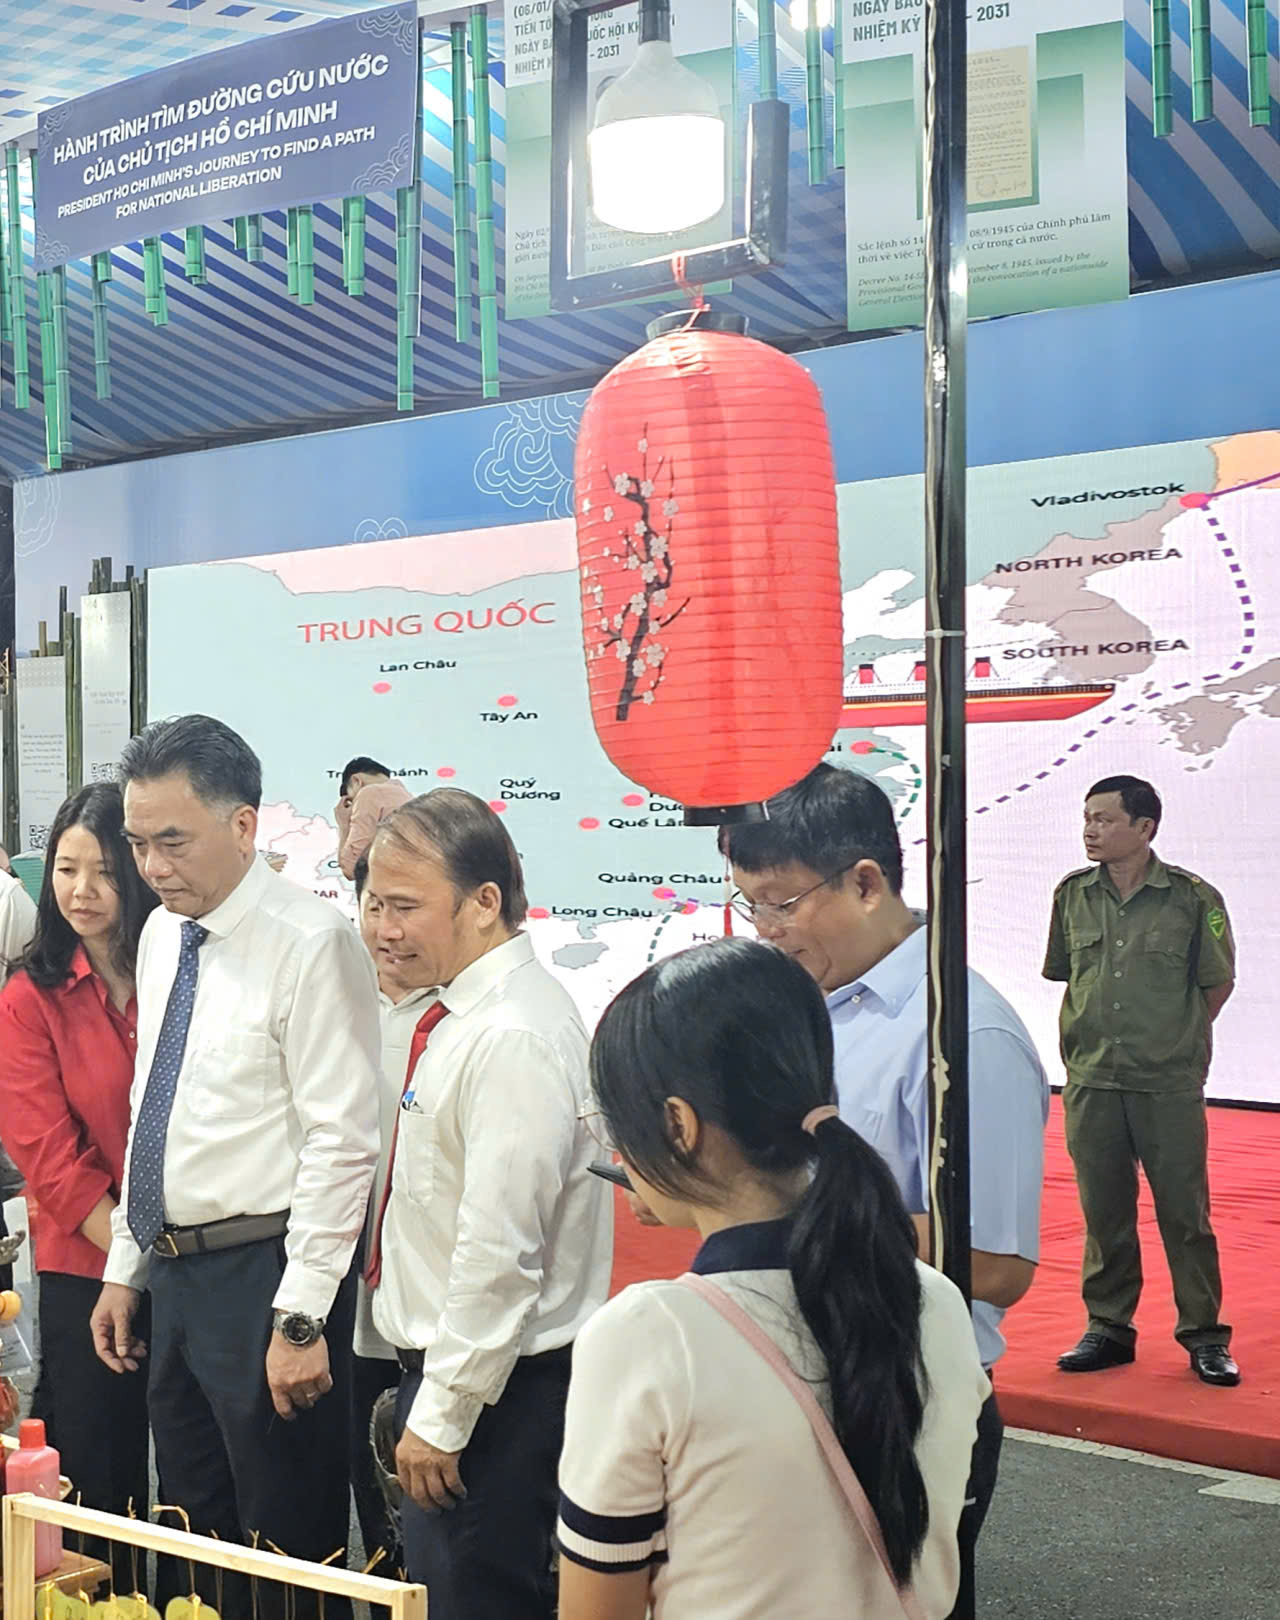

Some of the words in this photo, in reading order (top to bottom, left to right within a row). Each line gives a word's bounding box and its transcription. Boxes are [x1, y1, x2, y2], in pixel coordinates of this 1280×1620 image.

[853, 19, 896, 42] NHIỆM
[977, 3, 1009, 21] 2031
[597, 44, 620, 59] 2031
[54, 133, 98, 165] HÀNH
[100, 114, 149, 148] TRÌNH
[152, 104, 185, 131] TÌM
[187, 83, 263, 120] ĐƯỜNG
[266, 69, 315, 99] CỨU
[319, 53, 389, 89] NƯỚC
[83, 154, 116, 185] CỦA
[118, 140, 153, 173] CHỦ
[155, 132, 198, 164] TỊCH
[200, 116, 231, 150] HỒ
[234, 109, 275, 140] CHÍ
[275, 100, 338, 132] MINH
[58, 190, 113, 219] PRESIDENT
[113, 186, 129, 200] HO
[131, 180, 150, 195] CHI
[151, 165, 194, 189] MINH'S
[194, 149, 262, 176] JOURNEY
[261, 145, 281, 161] TO
[283, 137, 319, 157] FIND
[320, 135, 333, 150] A
[335, 126, 376, 147] PATH
[116, 202, 139, 219] FOR
[139, 182, 198, 213] NATIONAL
[199, 166, 283, 196] LIBERATION
[1037, 217, 1066, 229] Chính
[988, 238, 1014, 248] trong
[1031, 483, 1185, 507] Vladivostok
[995, 556, 1083, 574] NORTH
[1091, 548, 1183, 565] KOREA
[297, 614, 422, 643] TRUNG
[433, 598, 556, 634] QUỐC
[1003, 645, 1089, 660] SOUTH
[1098, 639, 1190, 655] KOREA
[380, 661, 409, 673] Lan
[413, 659, 457, 671] Châu
[479, 711, 509, 724] Tây
[512, 710, 538, 721] An
[500, 777, 537, 789] Quý
[608, 817, 649, 829] Quế
[598, 872, 664, 885] Quảng
[669, 873, 722, 884] Châu
[552, 906, 597, 918] Long
[603, 907, 654, 918] Châu
